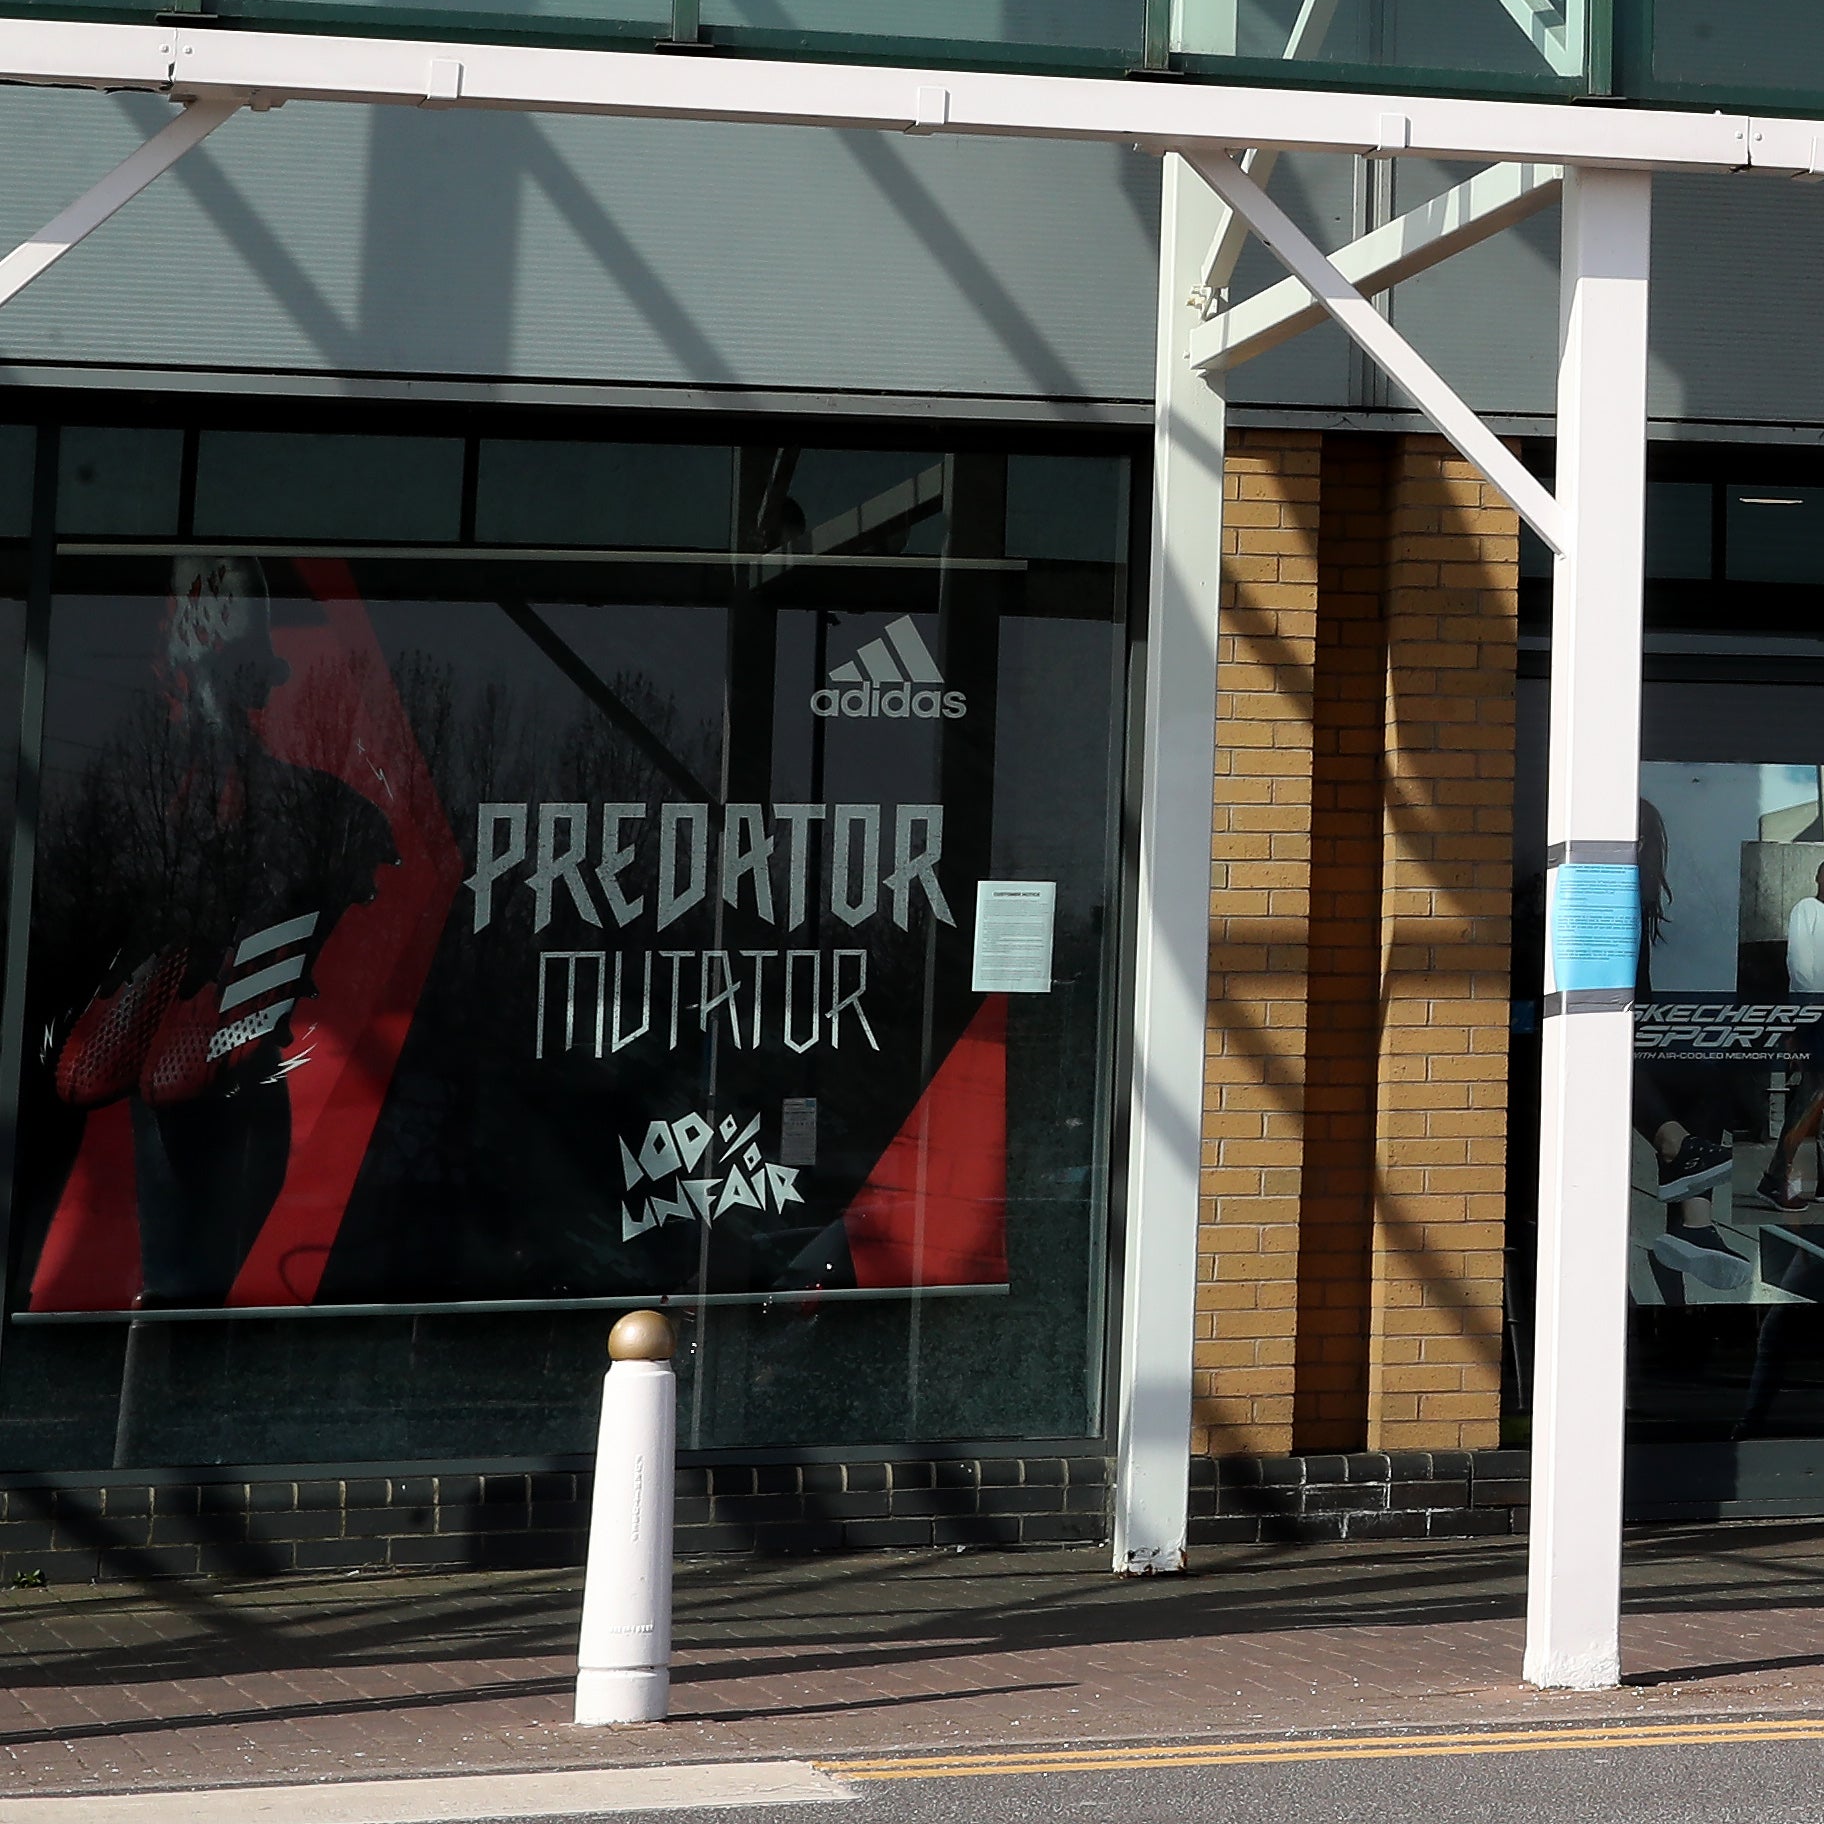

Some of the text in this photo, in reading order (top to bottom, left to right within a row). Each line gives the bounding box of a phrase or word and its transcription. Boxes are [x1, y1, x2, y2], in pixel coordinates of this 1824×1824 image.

[809, 681, 968, 719] adidas
[462, 802, 958, 935] PREDATOR
[535, 949, 881, 1060] MUTATOR
[1634, 1026, 1797, 1048] SPORT
[1656, 1052, 1724, 1060] AIR-COOLED
[1725, 1052, 1776, 1060] MEMORY
[1776, 1052, 1810, 1060] FOAM
[617, 1111, 762, 1192] 100%
[621, 1162, 807, 1244] UNFAIR
